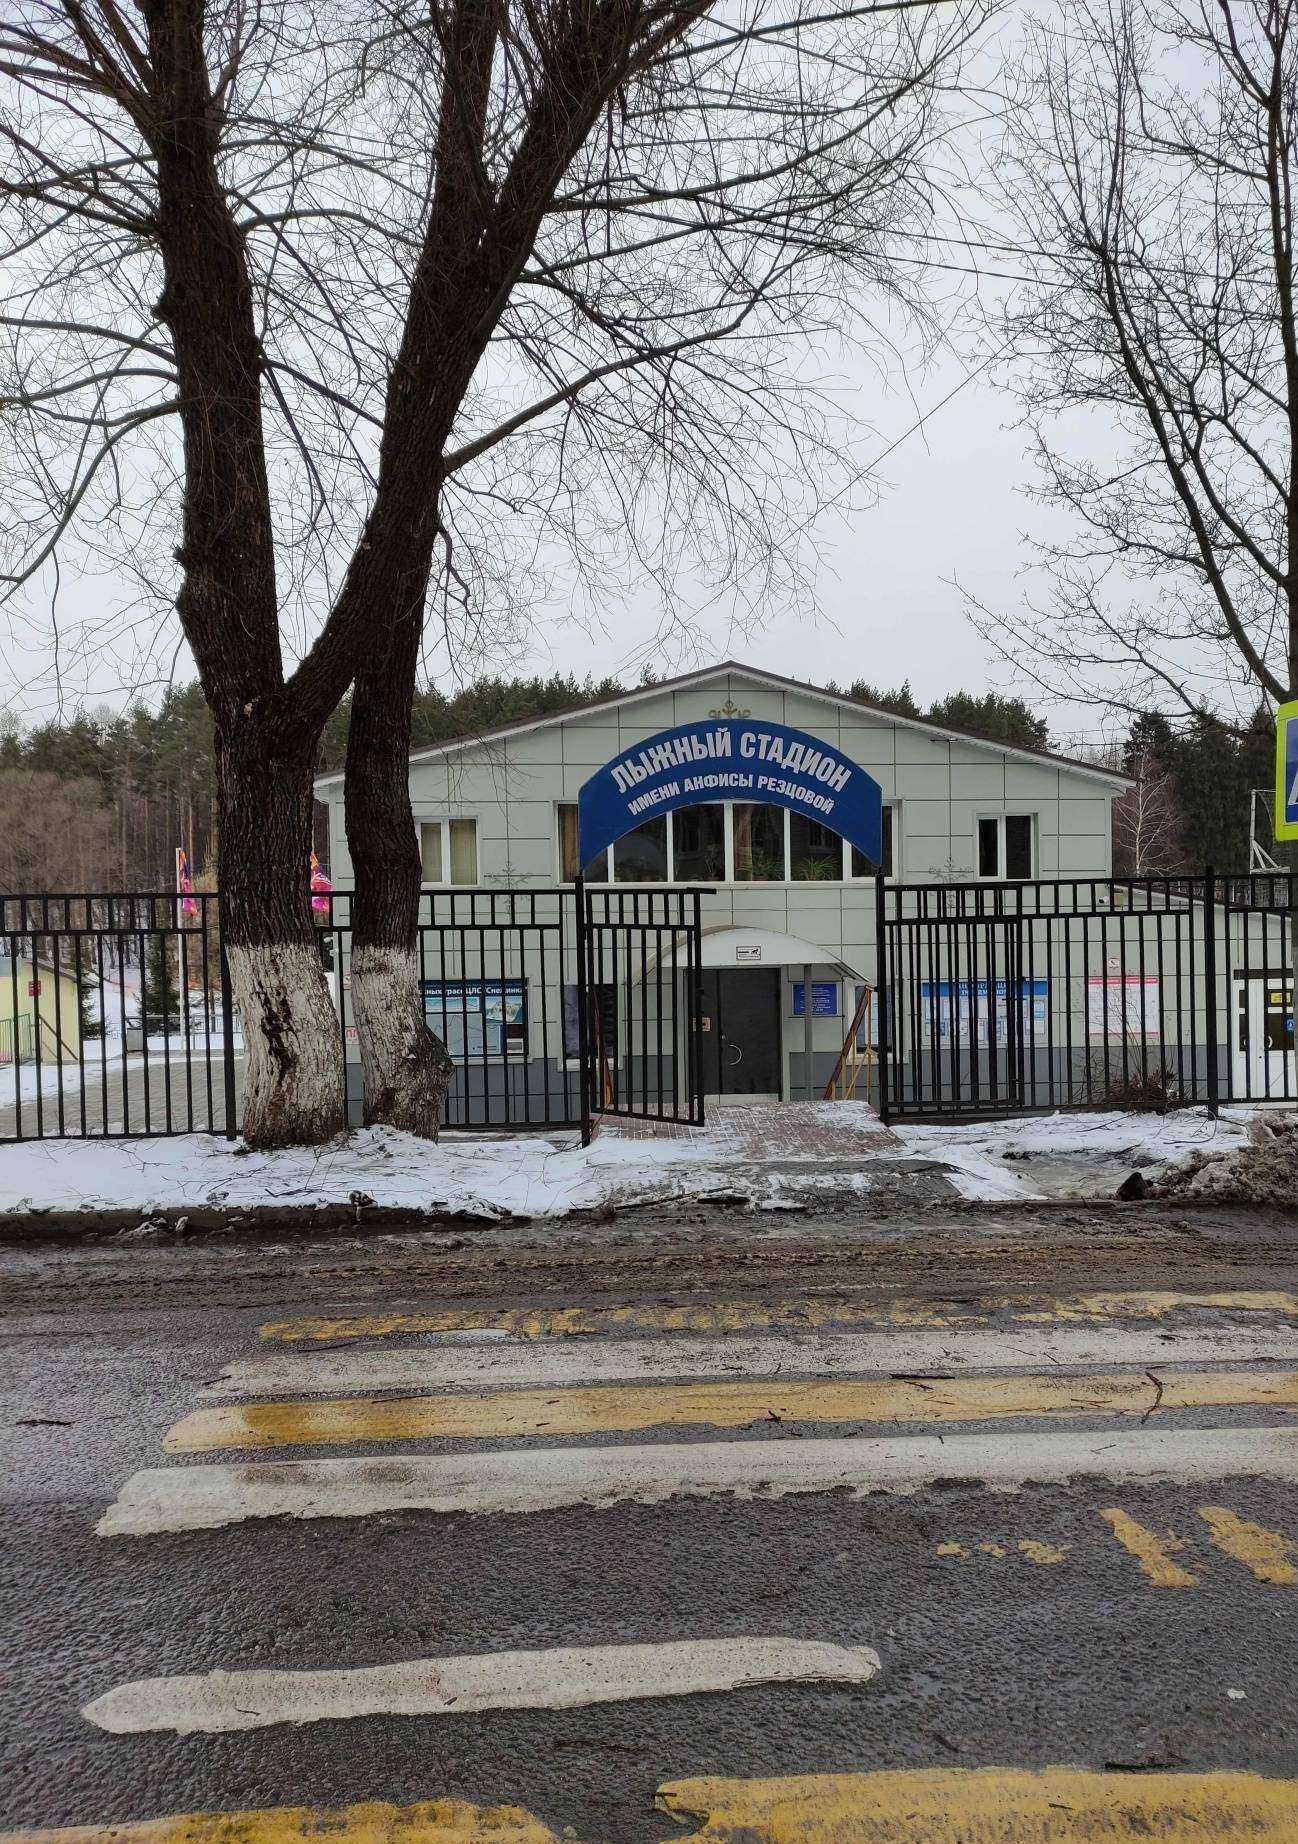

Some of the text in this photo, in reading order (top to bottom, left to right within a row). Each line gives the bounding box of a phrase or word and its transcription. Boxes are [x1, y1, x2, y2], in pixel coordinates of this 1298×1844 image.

[610, 727, 852, 794] ЛЫЖНЫЙ СТАДИОН
[627, 773, 835, 816] ИМЕНИ АНФИСЫ РЕЗЦОВОЙ
